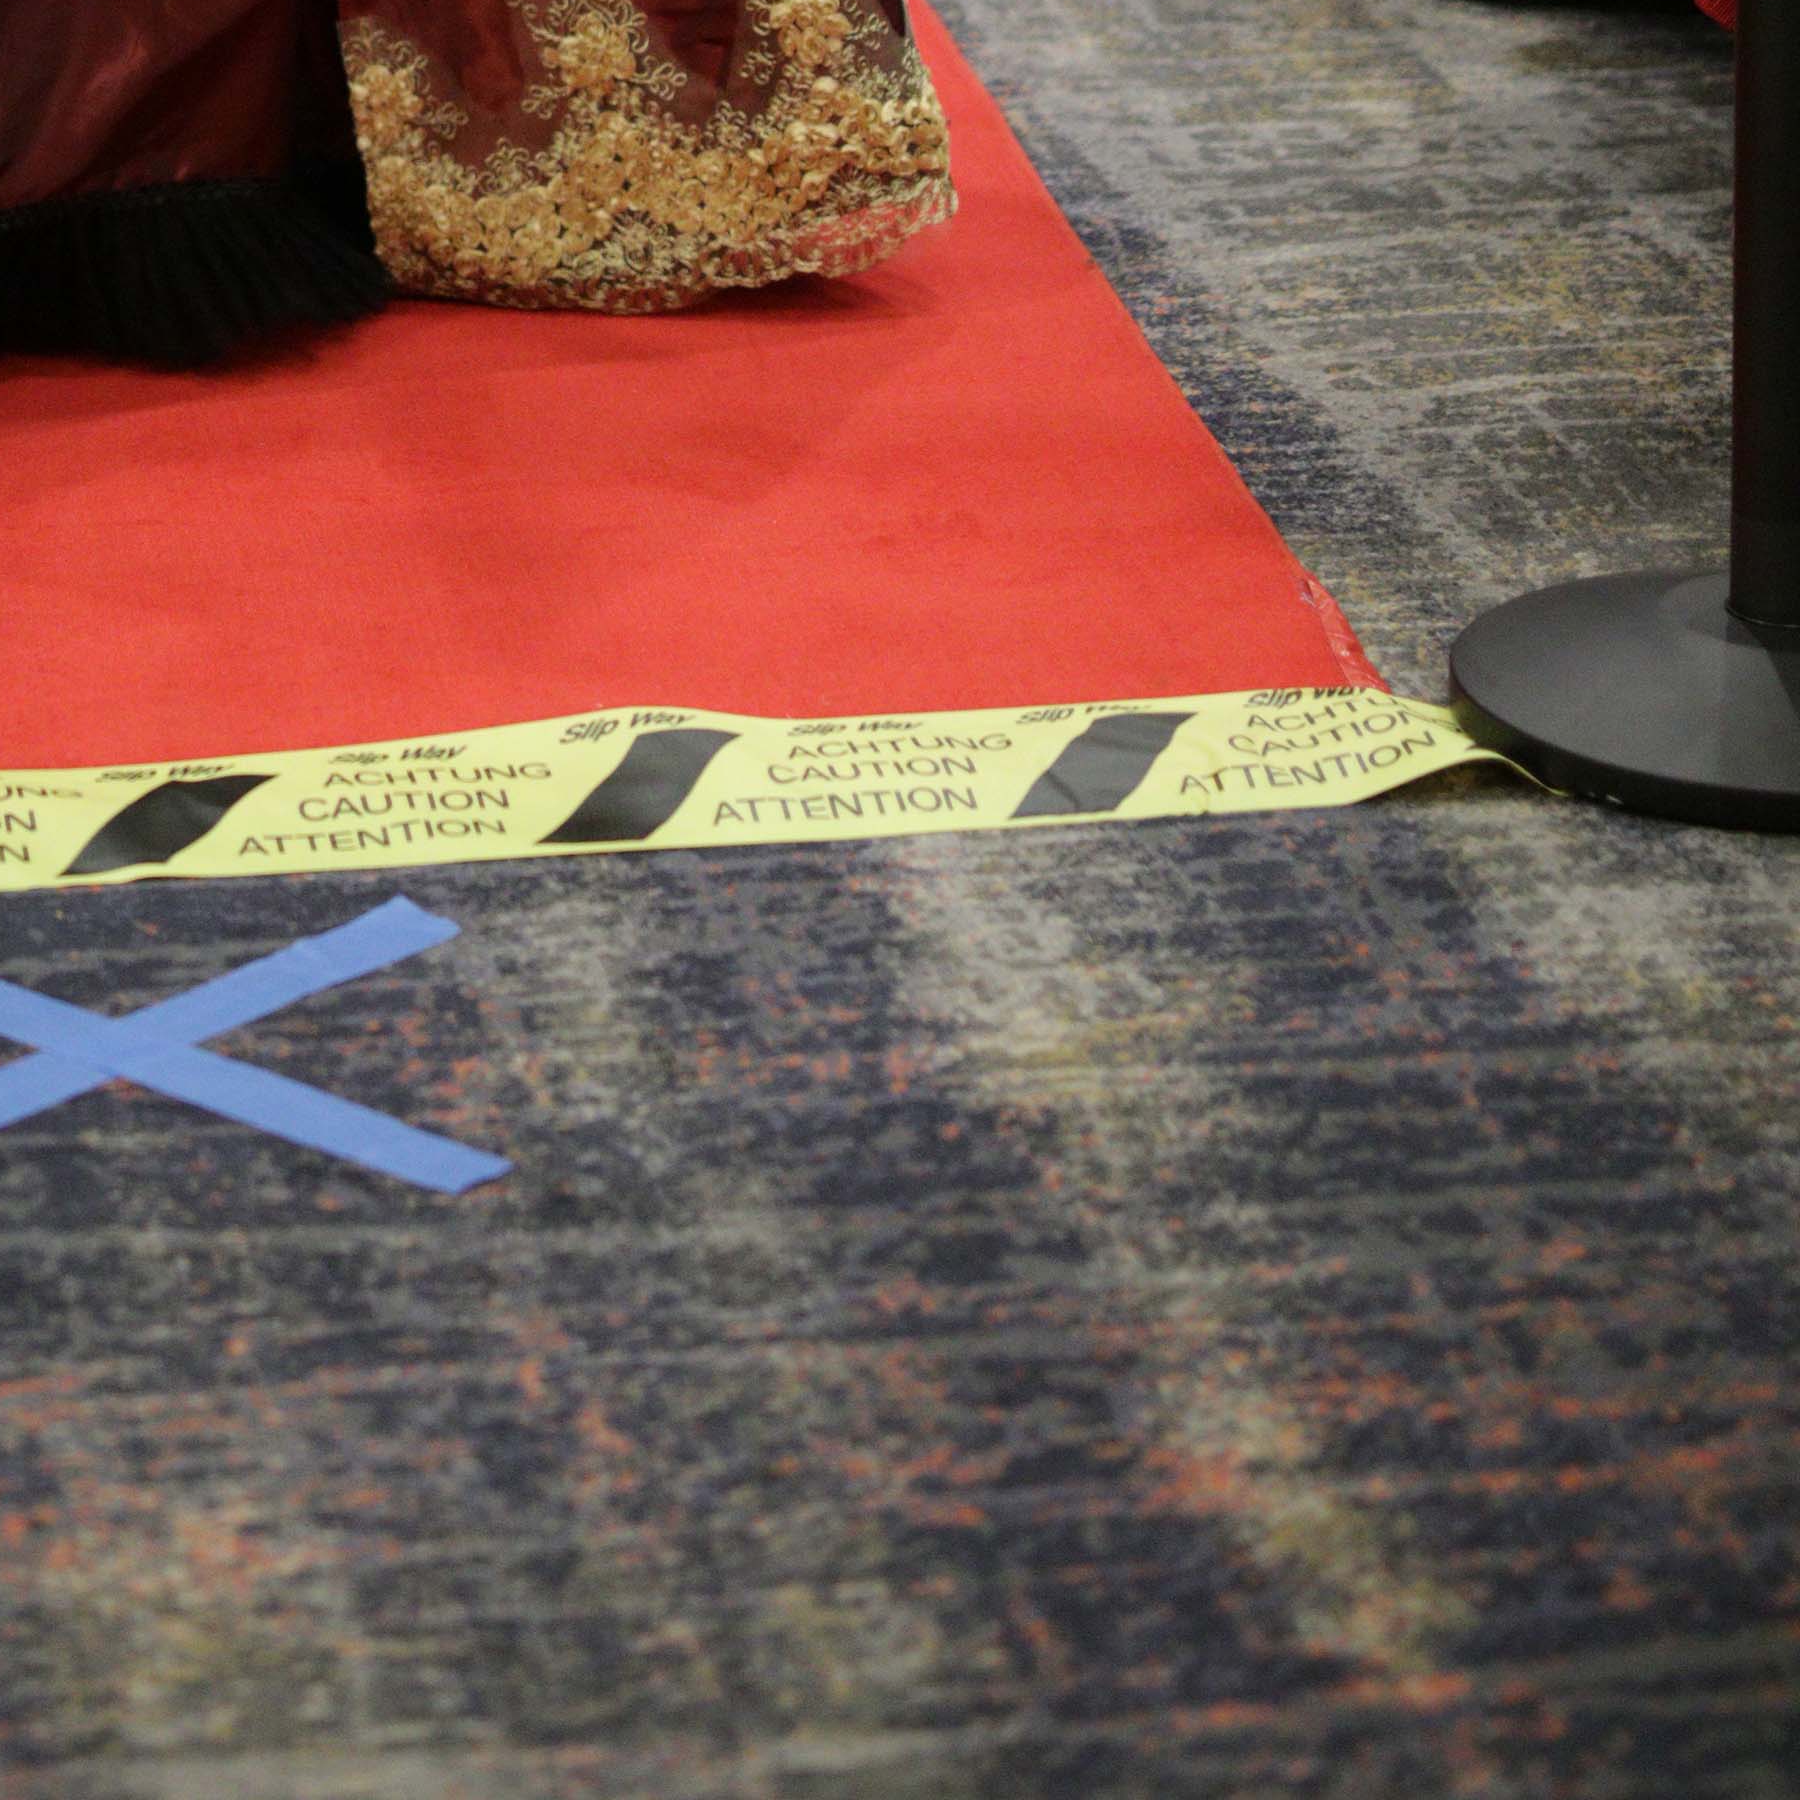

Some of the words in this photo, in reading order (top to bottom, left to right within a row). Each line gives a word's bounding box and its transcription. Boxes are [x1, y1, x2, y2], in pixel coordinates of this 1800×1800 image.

[1244, 687, 1303, 710] Slip
[559, 717, 620, 745] Slip
[629, 711, 696, 728] Way
[1016, 707, 1075, 725] Slip
[400, 744, 467, 761] Way
[788, 731, 1014, 760] ACHTUNG
[324, 762, 552, 788] ACHTUNG
[767, 756, 979, 784] CAUTION
[1180, 730, 1437, 794] ATTENTION
[298, 789, 511, 822] CAUTION
[712, 786, 980, 827] ATTENTION
[238, 819, 507, 857] ATTENTION
